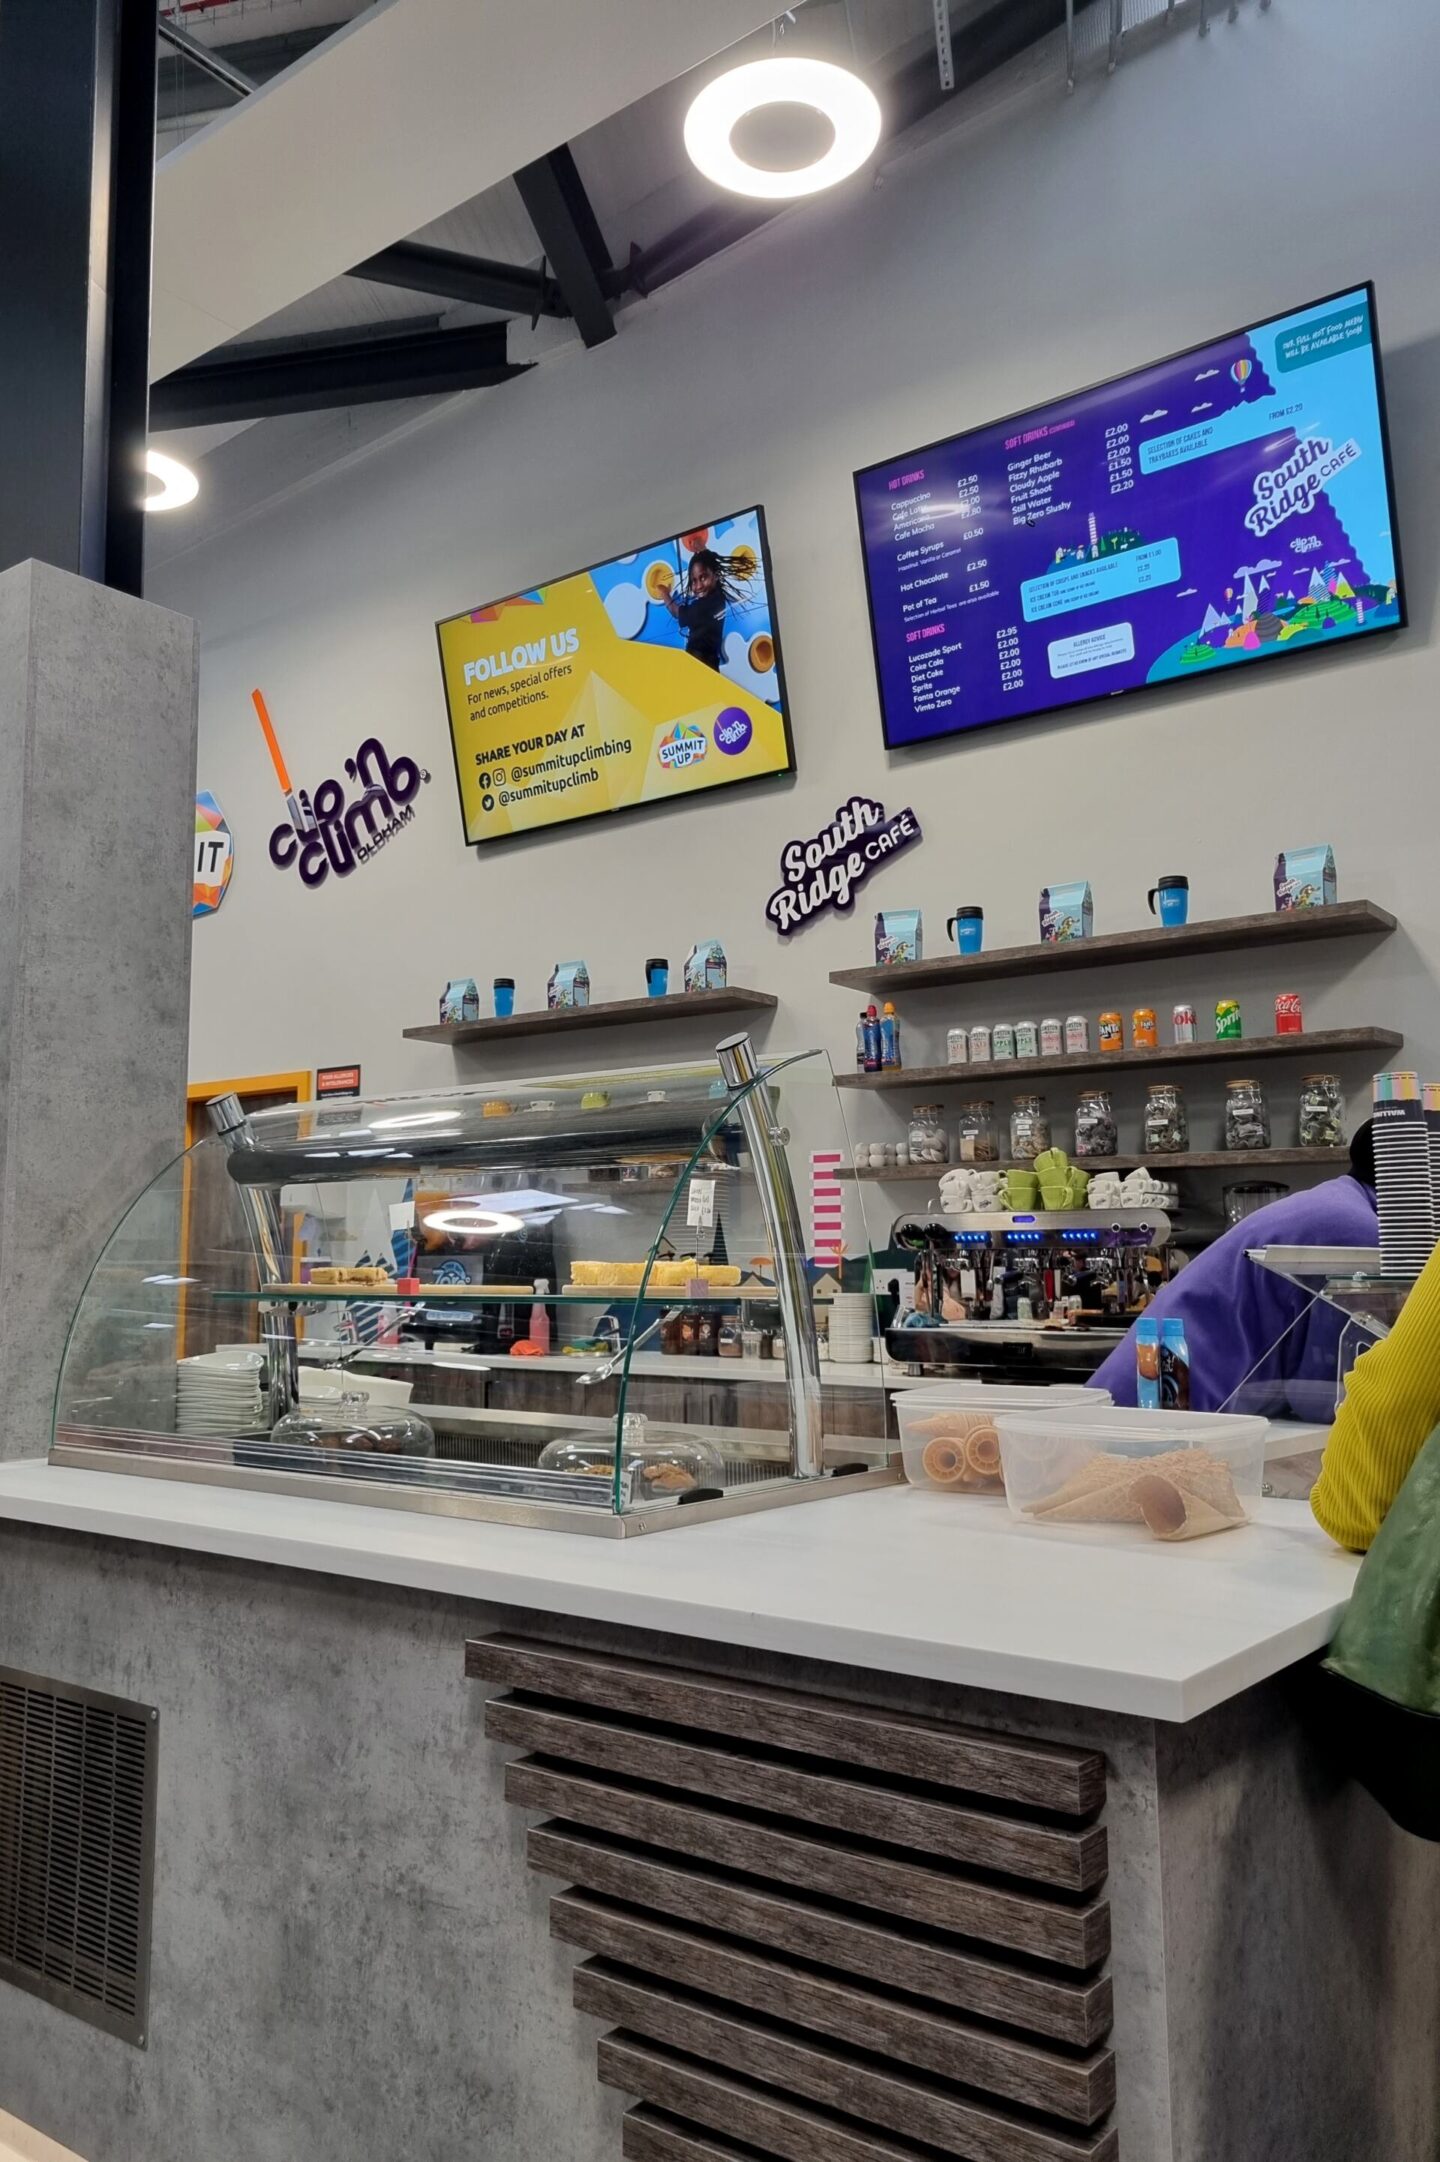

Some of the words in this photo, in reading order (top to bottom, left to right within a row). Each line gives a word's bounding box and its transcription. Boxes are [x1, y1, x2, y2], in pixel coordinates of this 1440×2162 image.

[1310, 332, 1345, 351] AVAILABLE
[1005, 435, 1021, 450] SOFT
[1022, 425, 1048, 444] DRINKS
[1007, 456, 1033, 472] Ginger
[1033, 450, 1052, 462] Beer
[1105, 422, 1128, 438] £2.00
[1008, 470, 1028, 482] Fizzy
[1029, 458, 1063, 475] Rhubarb
[1106, 434, 1130, 450] £2.00
[1009, 478, 1036, 493] Cloudy
[1037, 470, 1060, 484] Apple
[1107, 446, 1130, 460] £2.00
[1258, 440, 1329, 500] South
[888, 478, 900, 490] HOT
[901, 469, 924, 486] DRINKS
[891, 492, 931, 511] Cappuccino
[957, 474, 978, 488] £2.50
[958, 485, 979, 498] £2.50
[1010, 491, 1028, 504] Fruit
[1029, 484, 1053, 498] Shoot
[1108, 457, 1132, 472] £1.50
[1012, 502, 1026, 515] Still
[1027, 496, 1052, 509] Water
[1109, 468, 1133, 483] £1.50
[1249, 474, 1321, 534] Ridge
[1320, 443, 1357, 477] CAFÉ
[1012, 515, 1026, 526] Big
[1027, 510, 1044, 521] Zero
[1045, 500, 1072, 515] Slushy
[1110, 480, 1134, 494] £2.20
[894, 528, 910, 542] Cafe
[912, 522, 935, 536] Mocha
[896, 549, 919, 562] Coffee
[920, 541, 944, 556] Syrups
[963, 528, 984, 540] £0.50
[900, 583, 914, 592] Hot
[914, 572, 949, 588] Chocolate
[966, 559, 988, 572] £2.50
[902, 603, 915, 613] Pot
[916, 600, 924, 608] of
[924, 596, 938, 606] Tea
[969, 580, 990, 593] £1.50
[906, 630, 922, 643] SOFT
[922, 623, 946, 638] DRINKS
[908, 648, 941, 664] Lucozade
[942, 642, 962, 655] Sport
[996, 626, 1018, 639] £2.95
[464, 637, 546, 686] FOLLOW
[550, 628, 580, 657] US
[910, 662, 927, 673] Coke
[928, 658, 944, 670] Cola
[998, 637, 1019, 650] £2.00
[911, 672, 926, 684] Diet
[926, 668, 944, 680] Coke
[998, 648, 1020, 660] £2.00
[468, 692, 482, 705] For
[484, 684, 509, 700] news,
[510, 672, 542, 692] special
[543, 664, 572, 681] offers
[912, 682, 933, 694] Sprite
[1000, 658, 1022, 671] £2.00
[913, 692, 934, 704] Fanta
[934, 686, 960, 698] Orange
[1001, 668, 1022, 681] £2.00
[470, 708, 486, 722] and
[487, 690, 549, 716] competitions.
[914, 702, 936, 713] Vimto
[936, 698, 952, 709] Zero
[1002, 679, 1024, 692] £2.00
[475, 746, 512, 766] SHARE
[512, 736, 544, 755] YOUR
[545, 728, 568, 747] DAY
[570, 724, 586, 740] AT
[511, 739, 632, 782] @summitupclimbing
[662, 740, 704, 760] SUMMIT
[676, 752, 692, 764] UP
[498, 768, 599, 806] @summitupclimb
[357, 804, 415, 862] OLDHAM
[785, 801, 879, 882] South
[770, 852, 866, 930] Ridge
[865, 814, 915, 860] CAFÉ
